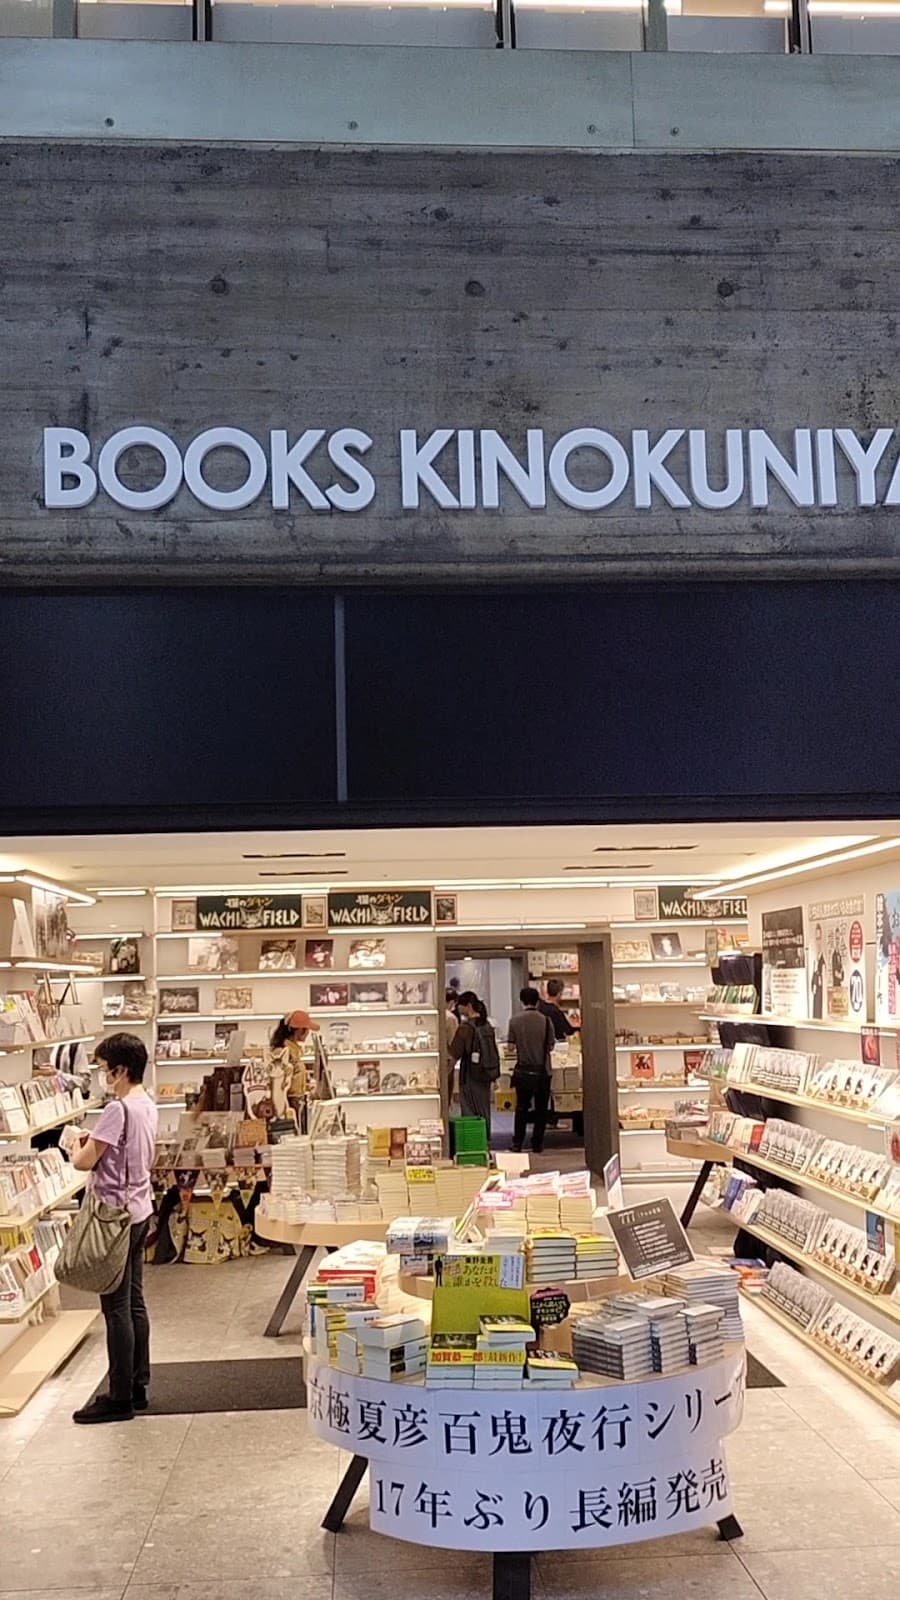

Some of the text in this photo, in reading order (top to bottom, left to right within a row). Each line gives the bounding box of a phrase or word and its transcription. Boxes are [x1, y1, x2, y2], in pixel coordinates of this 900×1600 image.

[44, 426, 376, 512] BOOKS
[199, 909, 300, 927] WACHI FIELD
[330, 906, 429, 924] WACHI FIELD
[661, 900, 701, 916] WACHI
[309, 1377, 742, 1456] 京極夏彦百鬼夜行シリー
[375, 1458, 728, 1532] 17年ぶり長編発売
